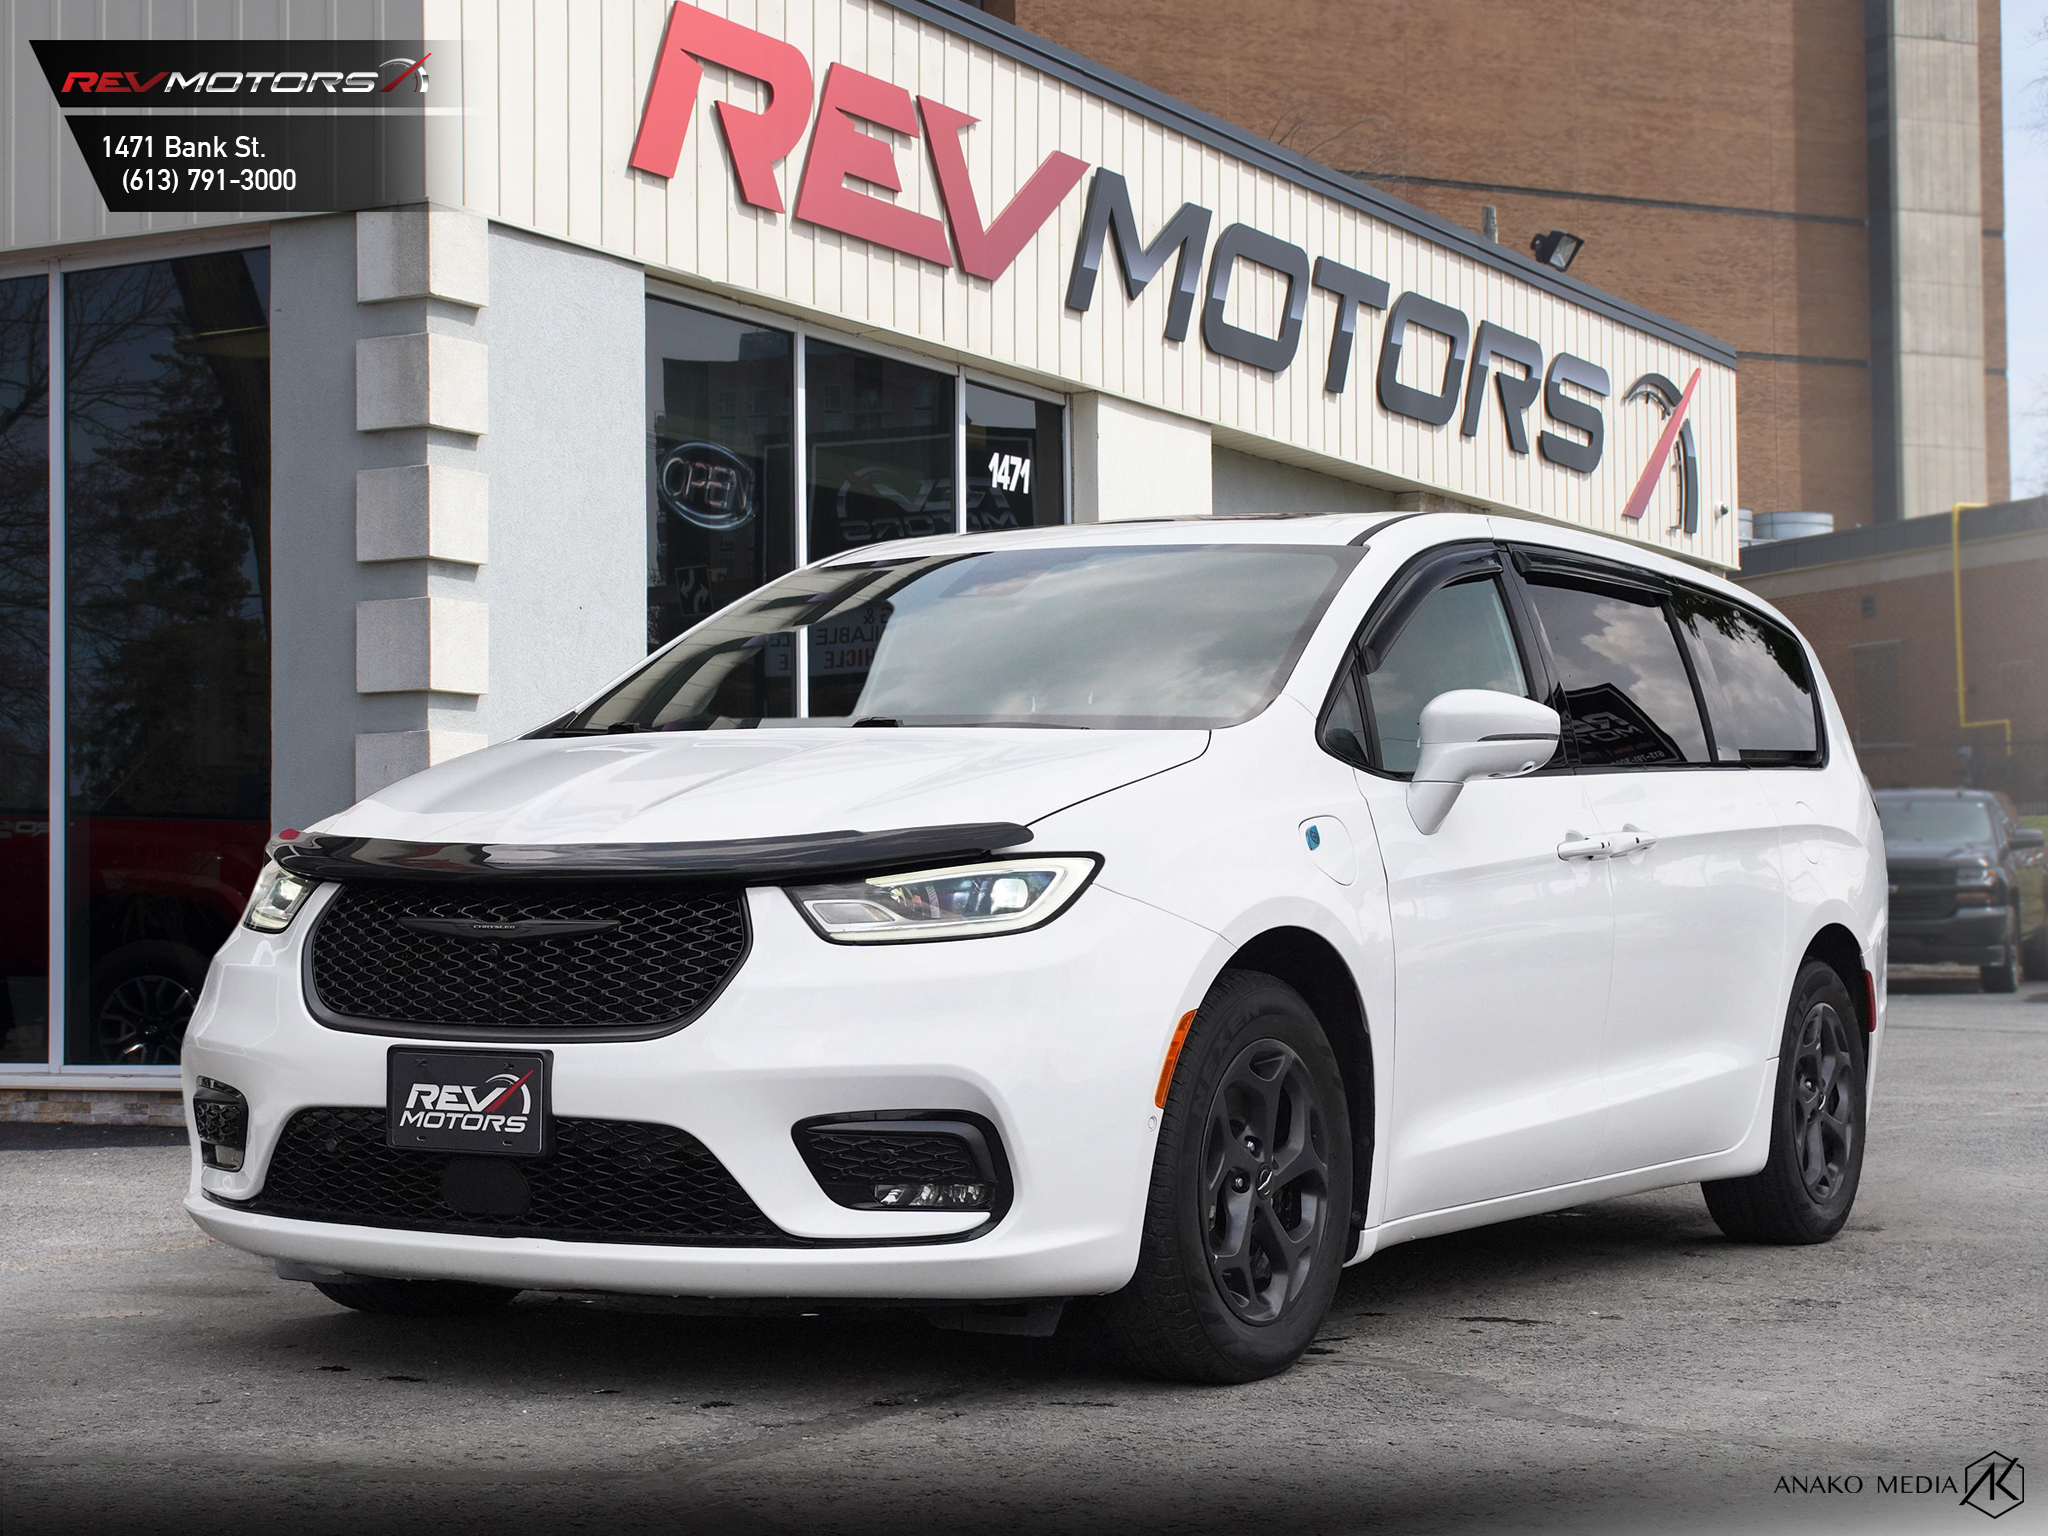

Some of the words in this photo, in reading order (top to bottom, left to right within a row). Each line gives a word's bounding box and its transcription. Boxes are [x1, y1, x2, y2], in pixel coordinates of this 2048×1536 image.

[662, 456, 750, 510] OPEN
[988, 452, 1031, 494] 1471
[405, 1083, 508, 1113] REV
[399, 1111, 528, 1133] MOTORS
